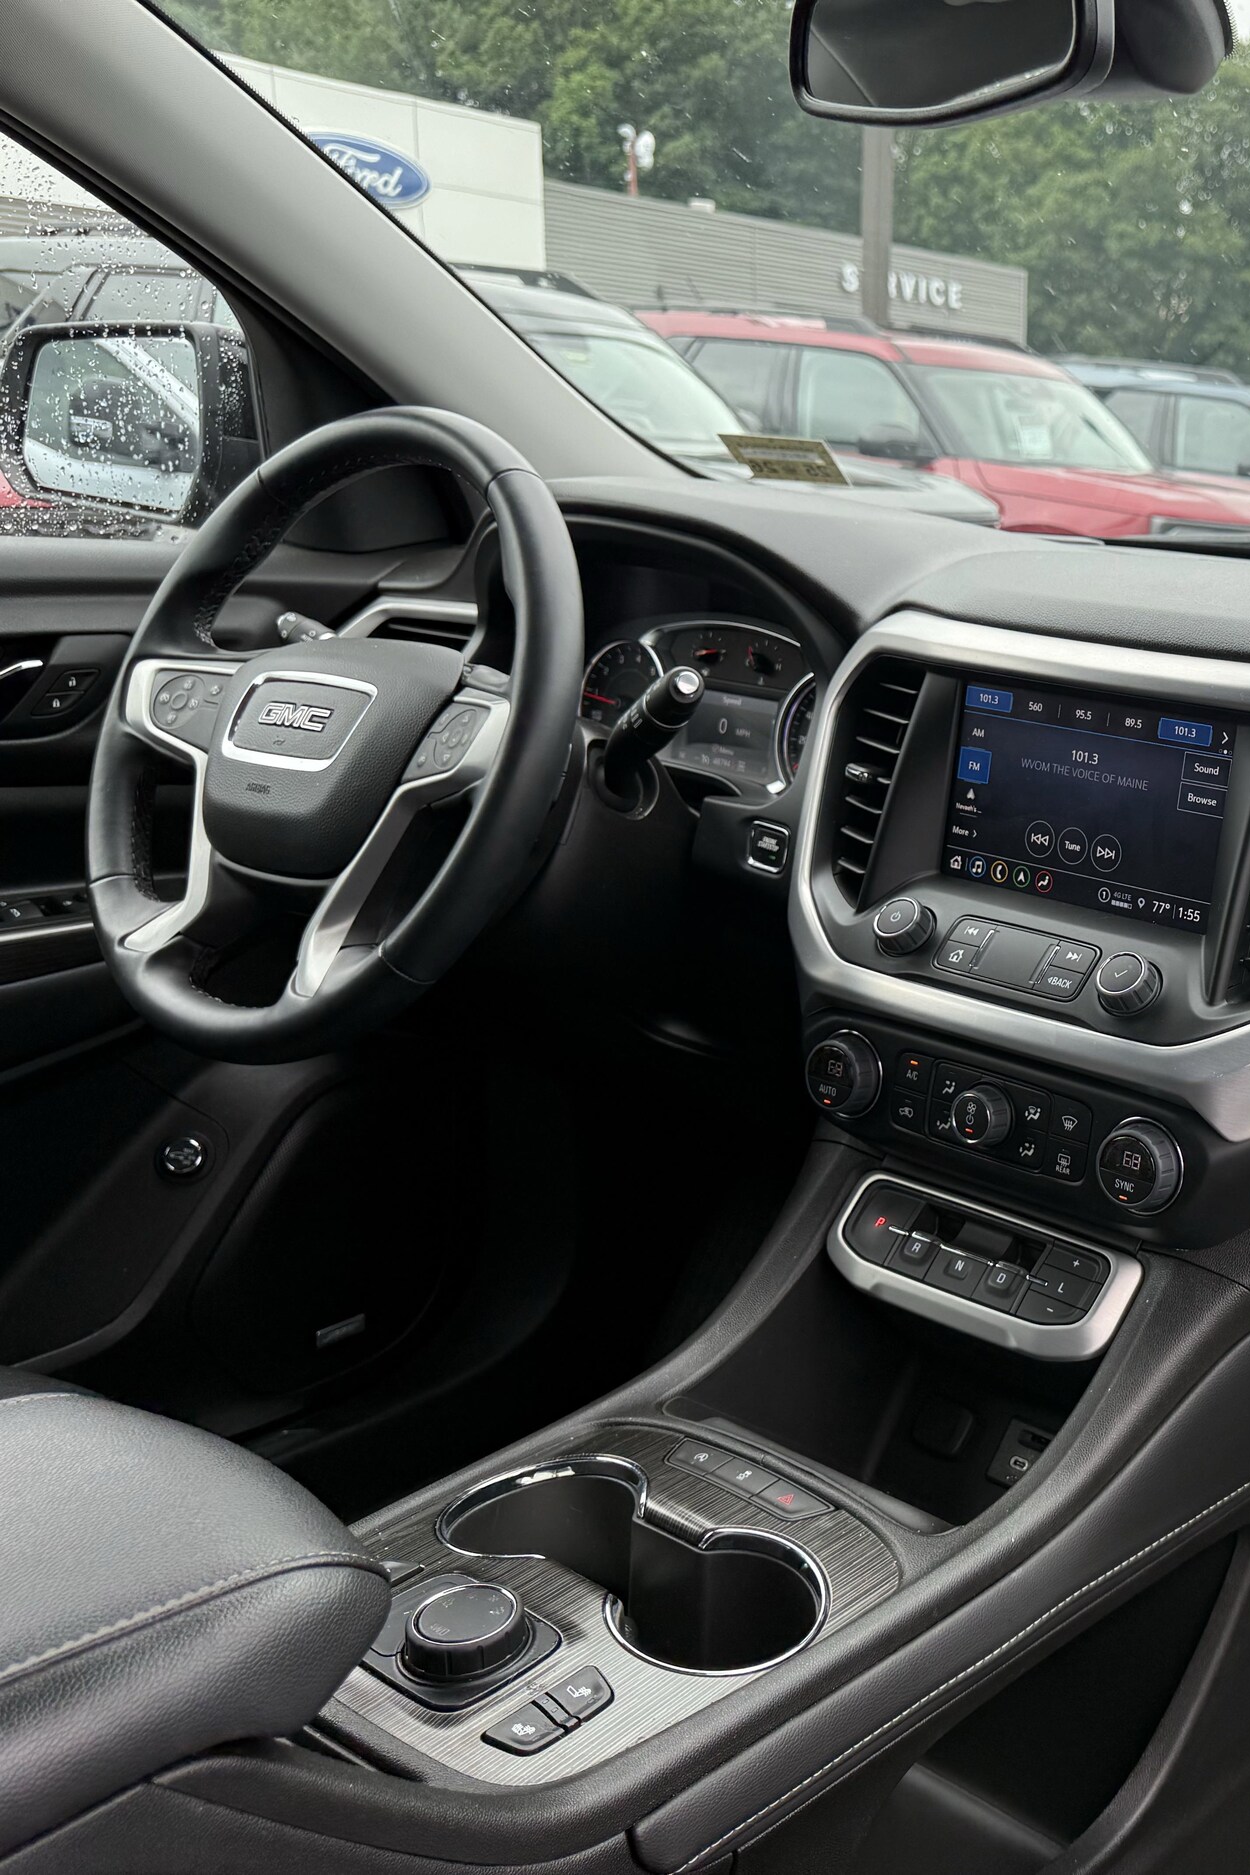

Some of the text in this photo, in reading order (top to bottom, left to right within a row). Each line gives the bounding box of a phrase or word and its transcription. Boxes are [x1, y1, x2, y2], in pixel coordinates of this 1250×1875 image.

[841, 262, 963, 310] SRVICE
[979, 693, 999, 705] 101.3
[1028, 701, 1043, 712] 560
[258, 701, 334, 733] GMC
[1075, 709, 1092, 720] 95.5
[719, 718, 751, 738] 0 MPH
[1124, 717, 1142, 729] 89.5
[972, 727, 985, 738] AM
[1174, 725, 1197, 738] 101.3
[1071, 750, 1099, 765] 101.3
[968, 761, 980, 771] FM
[1194, 762, 1220, 776] Sound
[1021, 758, 1149, 791] WVOM THE VOICE OF MAINE
[1187, 792, 1217, 807] Browse
[952, 825, 969, 836] More
[1064, 840, 1081, 852] Tune
[1122, 892, 1132, 901] LTE
[1178, 907, 1201, 922] 1:55
[1051, 976, 1073, 989] BACK
[906, 1069, 919, 1081] A/C
[818, 1084, 837, 1097] AUTO
[1122, 1151, 1141, 1171] 68
[1055, 1165, 1071, 1176] REAR
[1114, 1178, 1135, 1193] SYNC
[874, 1217, 886, 1228] P
[911, 1243, 921, 1254] R
[954, 1260, 965, 1272] N
[996, 1273, 1007, 1284] D
[1057, 1282, 1065, 1294] L
